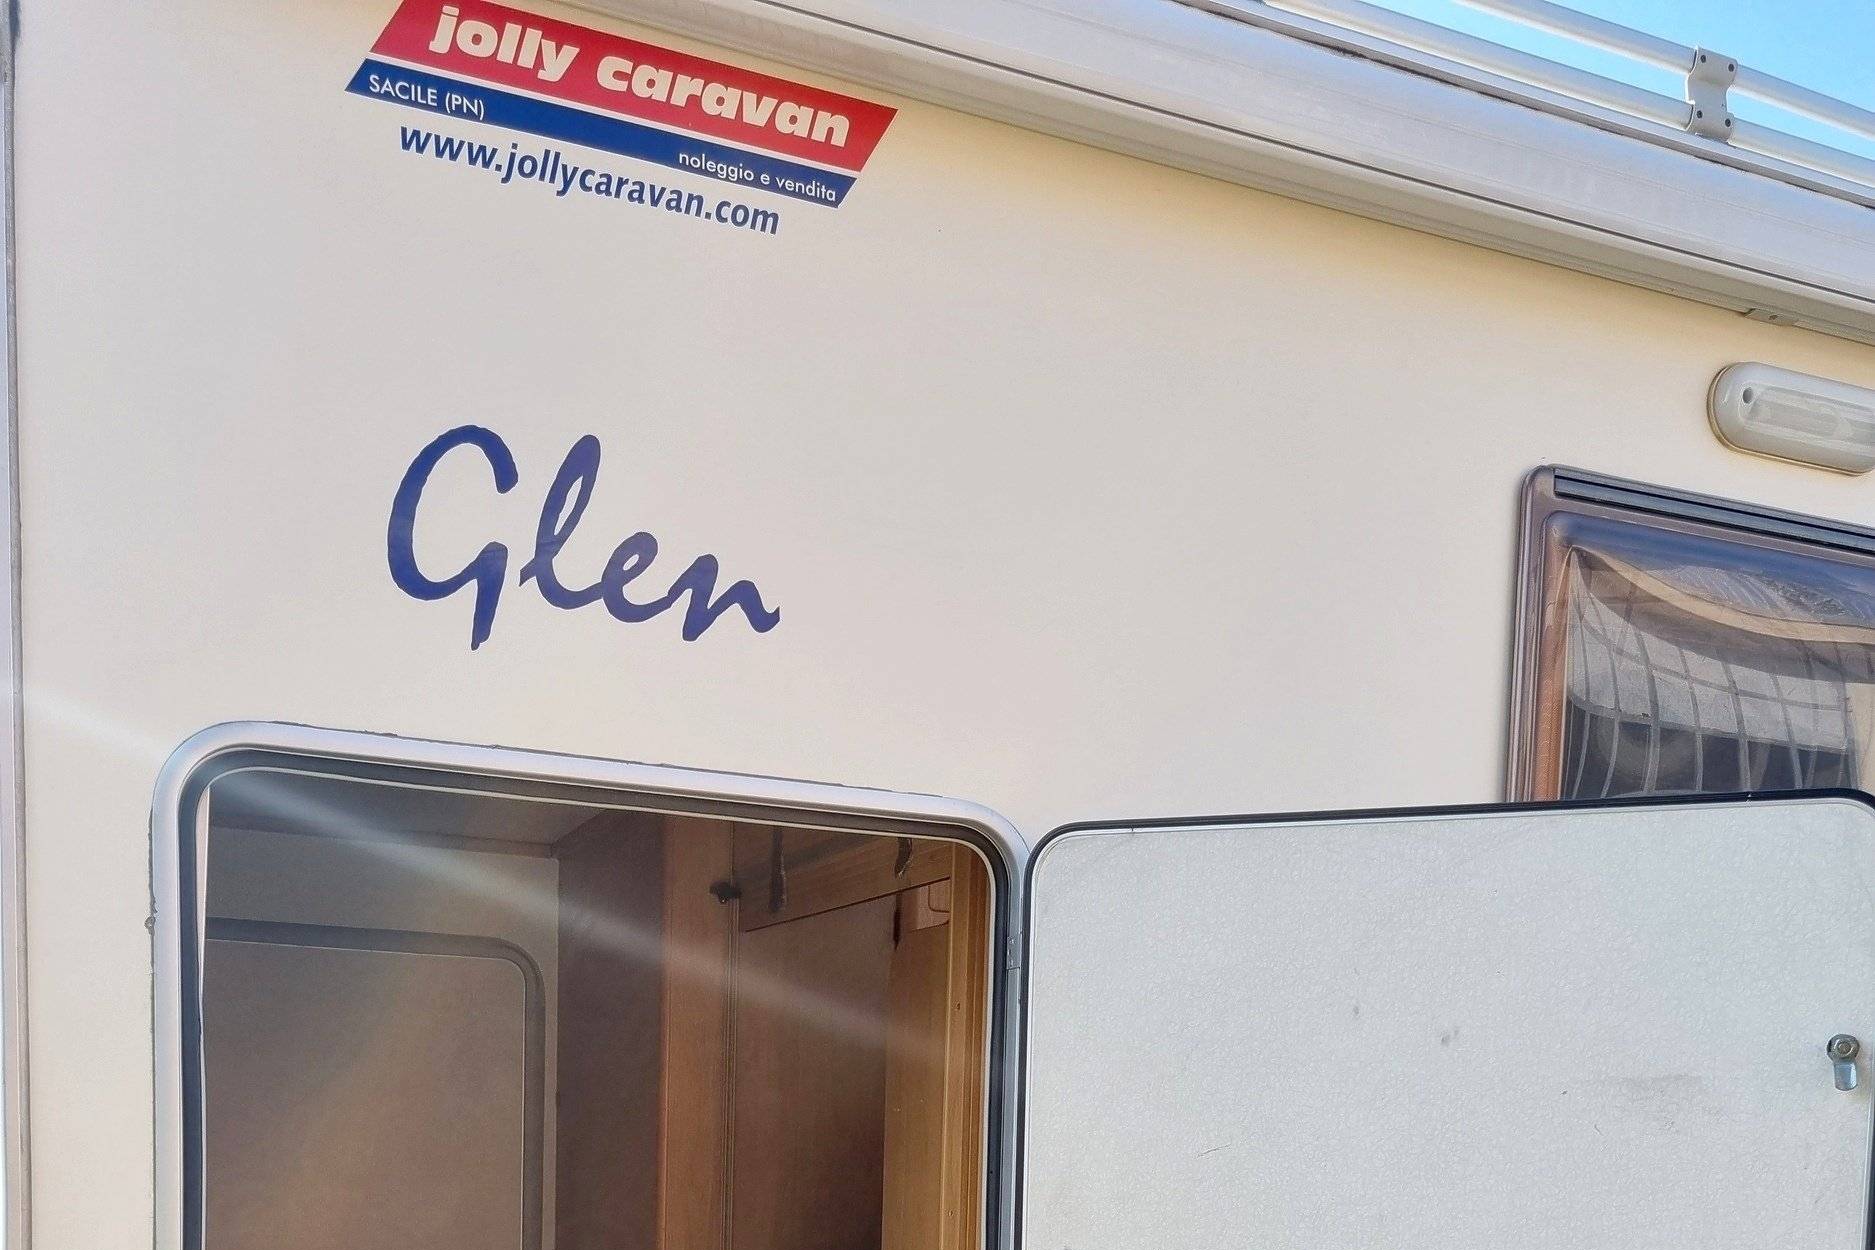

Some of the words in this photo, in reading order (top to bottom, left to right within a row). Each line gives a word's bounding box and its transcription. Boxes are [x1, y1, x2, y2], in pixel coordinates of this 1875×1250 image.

[368, 74, 438, 107] SACILE
[445, 92, 485, 121] (PN)
[429, 5, 580, 83] jolly
[596, 55, 852, 148] caravan
[400, 125, 780, 235] www.jollycaravan.com
[678, 152, 755, 182] noleggio
[760, 172, 771, 185] e
[775, 176, 837, 202] vendita
[386, 424, 781, 652] Glen
